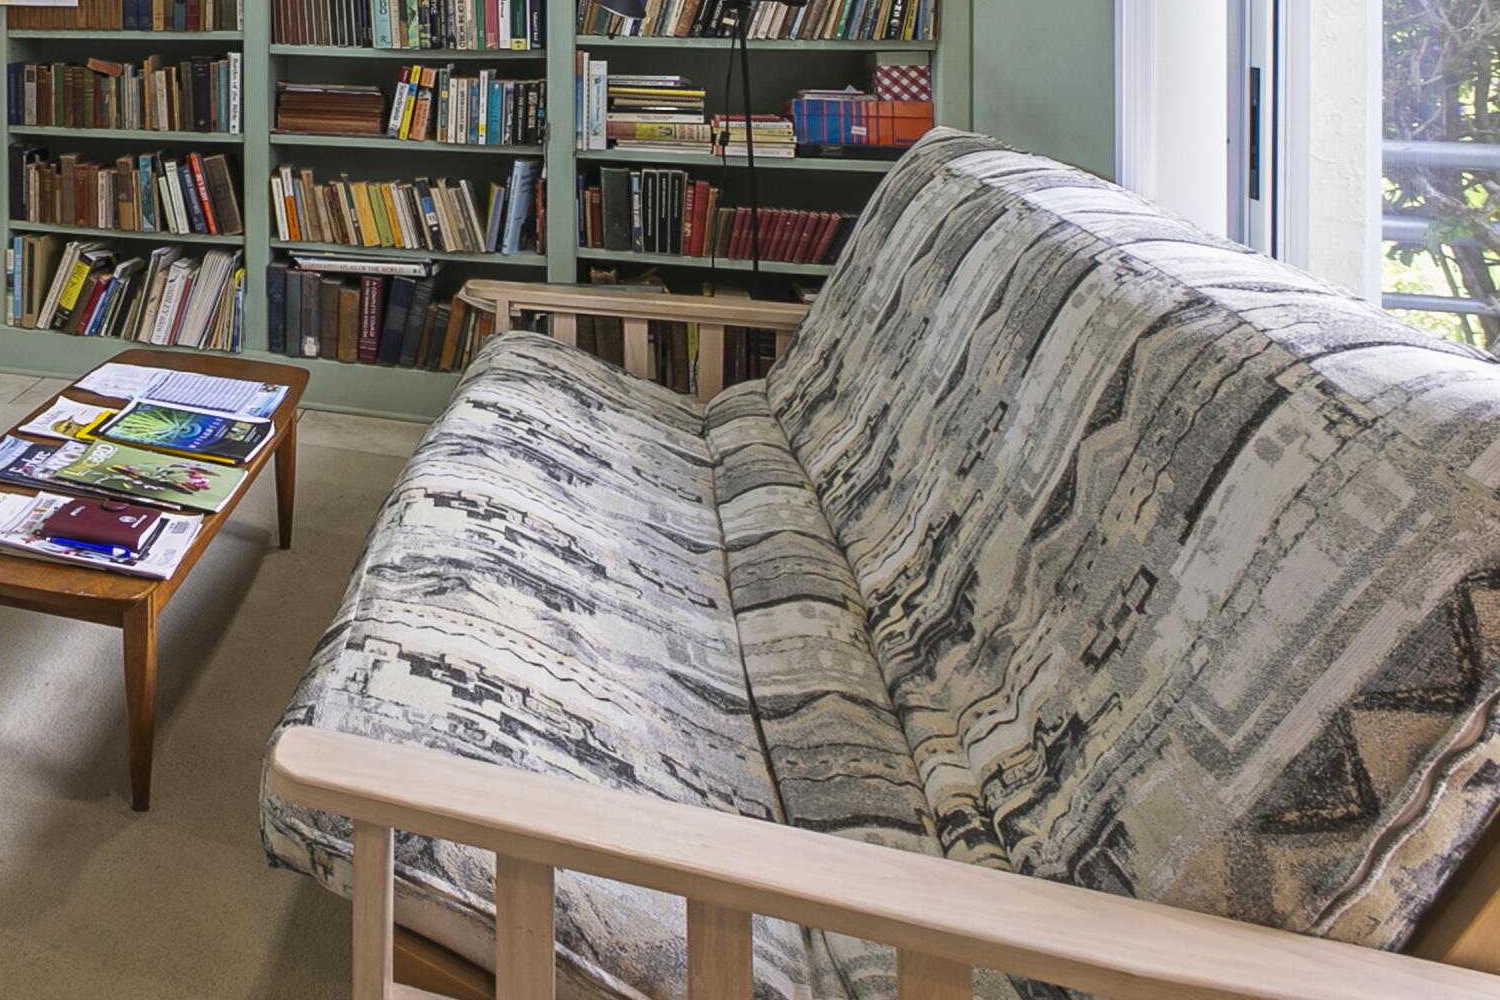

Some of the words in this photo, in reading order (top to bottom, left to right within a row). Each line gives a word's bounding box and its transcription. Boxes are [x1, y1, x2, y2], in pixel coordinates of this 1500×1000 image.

[458, 5, 465, 13] OF
[458, 25, 466, 48] WORLD
[231, 81, 238, 89] of
[231, 104, 239, 121] Bible
[393, 84, 407, 121] Scandinavia
[161, 287, 176, 317] SIBLEY
